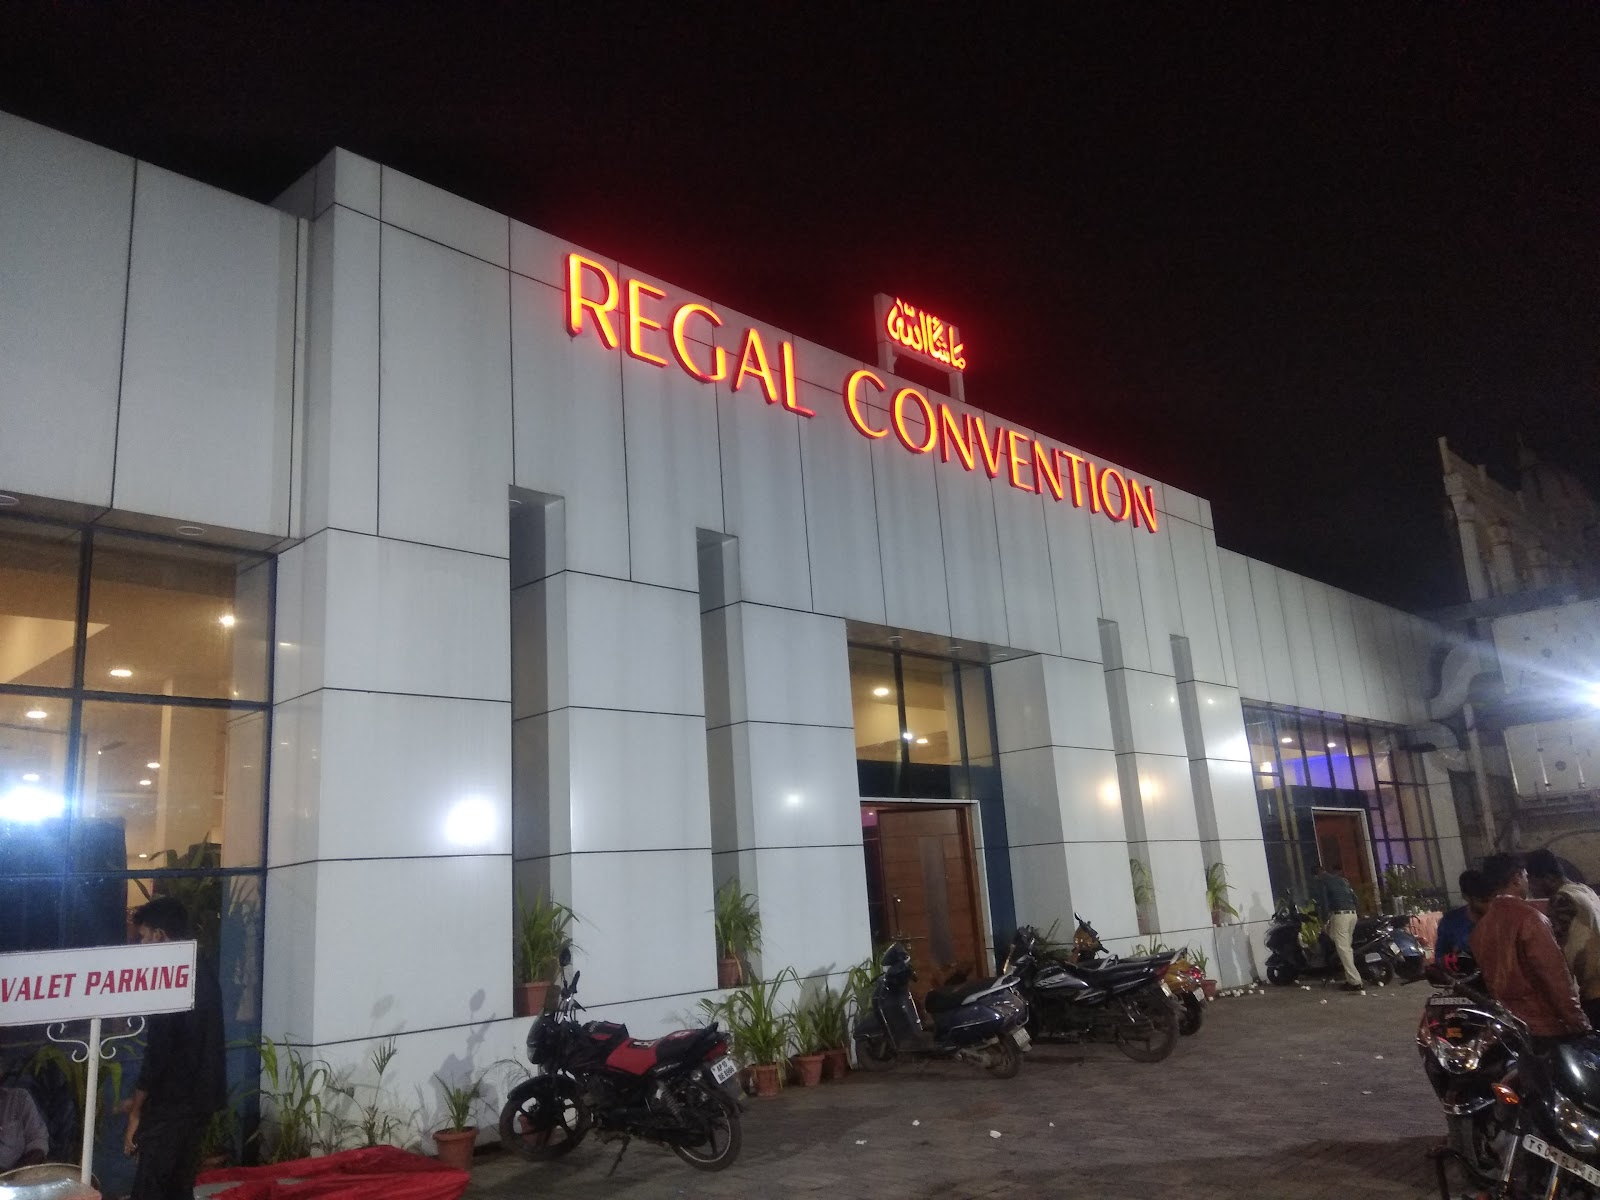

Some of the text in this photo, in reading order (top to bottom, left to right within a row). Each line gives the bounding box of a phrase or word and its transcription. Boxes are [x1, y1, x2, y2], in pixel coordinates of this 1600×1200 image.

[565, 252, 1158, 534] REGAL CONVENTION
[1, 964, 190, 1003] VALET PARKING
